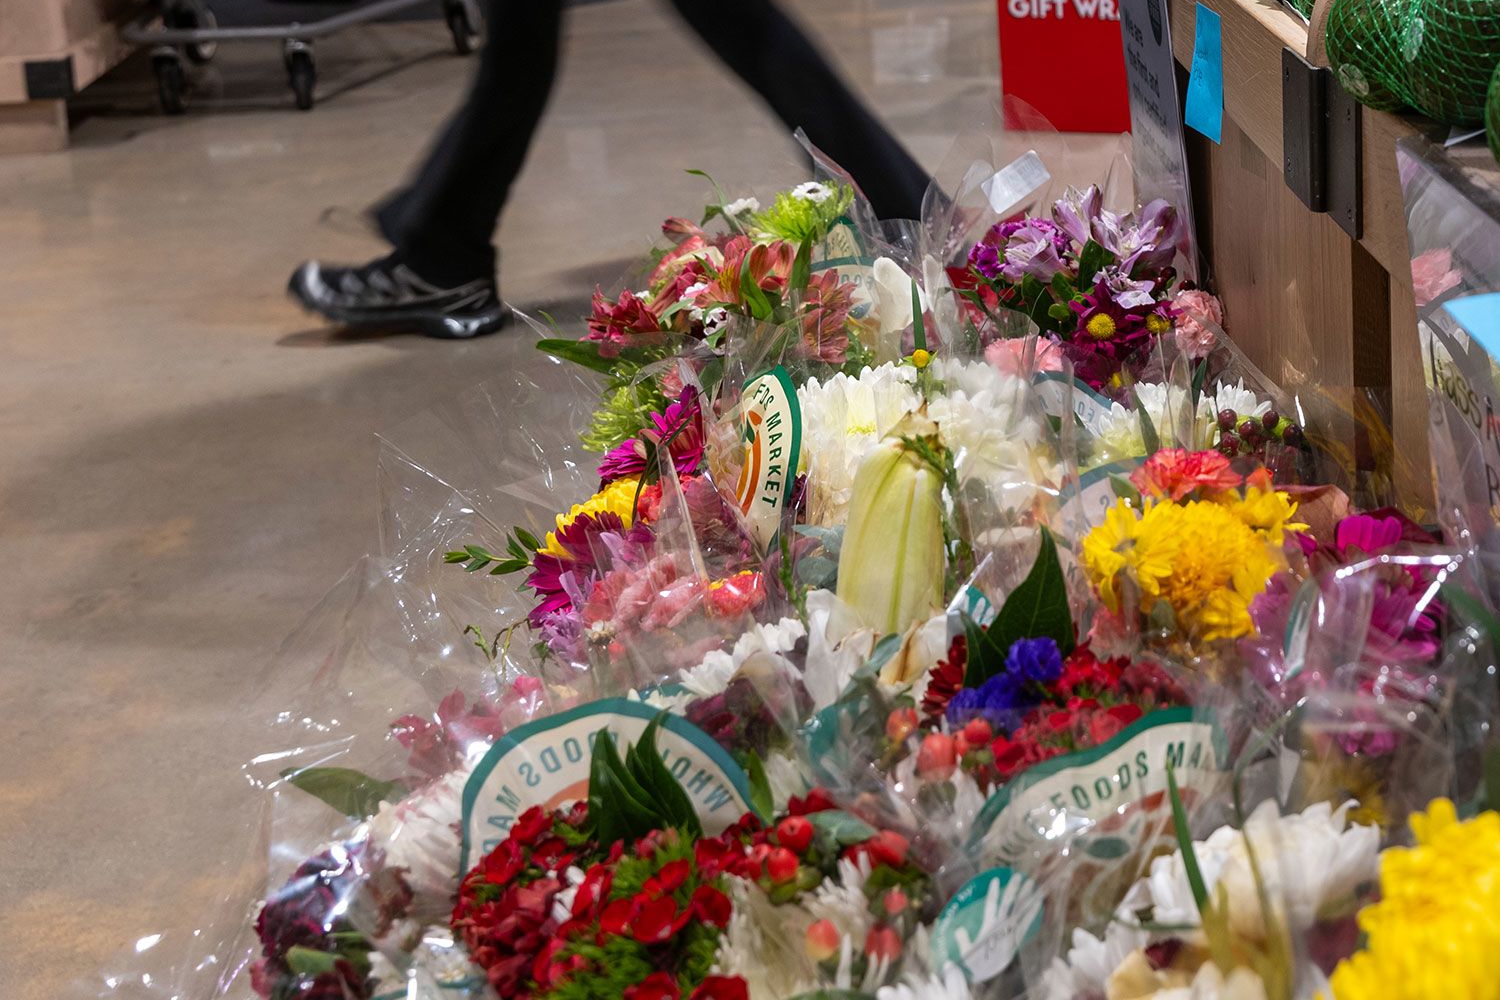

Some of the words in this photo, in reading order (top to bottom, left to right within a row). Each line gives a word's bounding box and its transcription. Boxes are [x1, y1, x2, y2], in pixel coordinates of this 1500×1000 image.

[761, 411, 783, 508] MARKET
[1049, 750, 1150, 812] FOODS
[1165, 740, 1203, 769] MA
